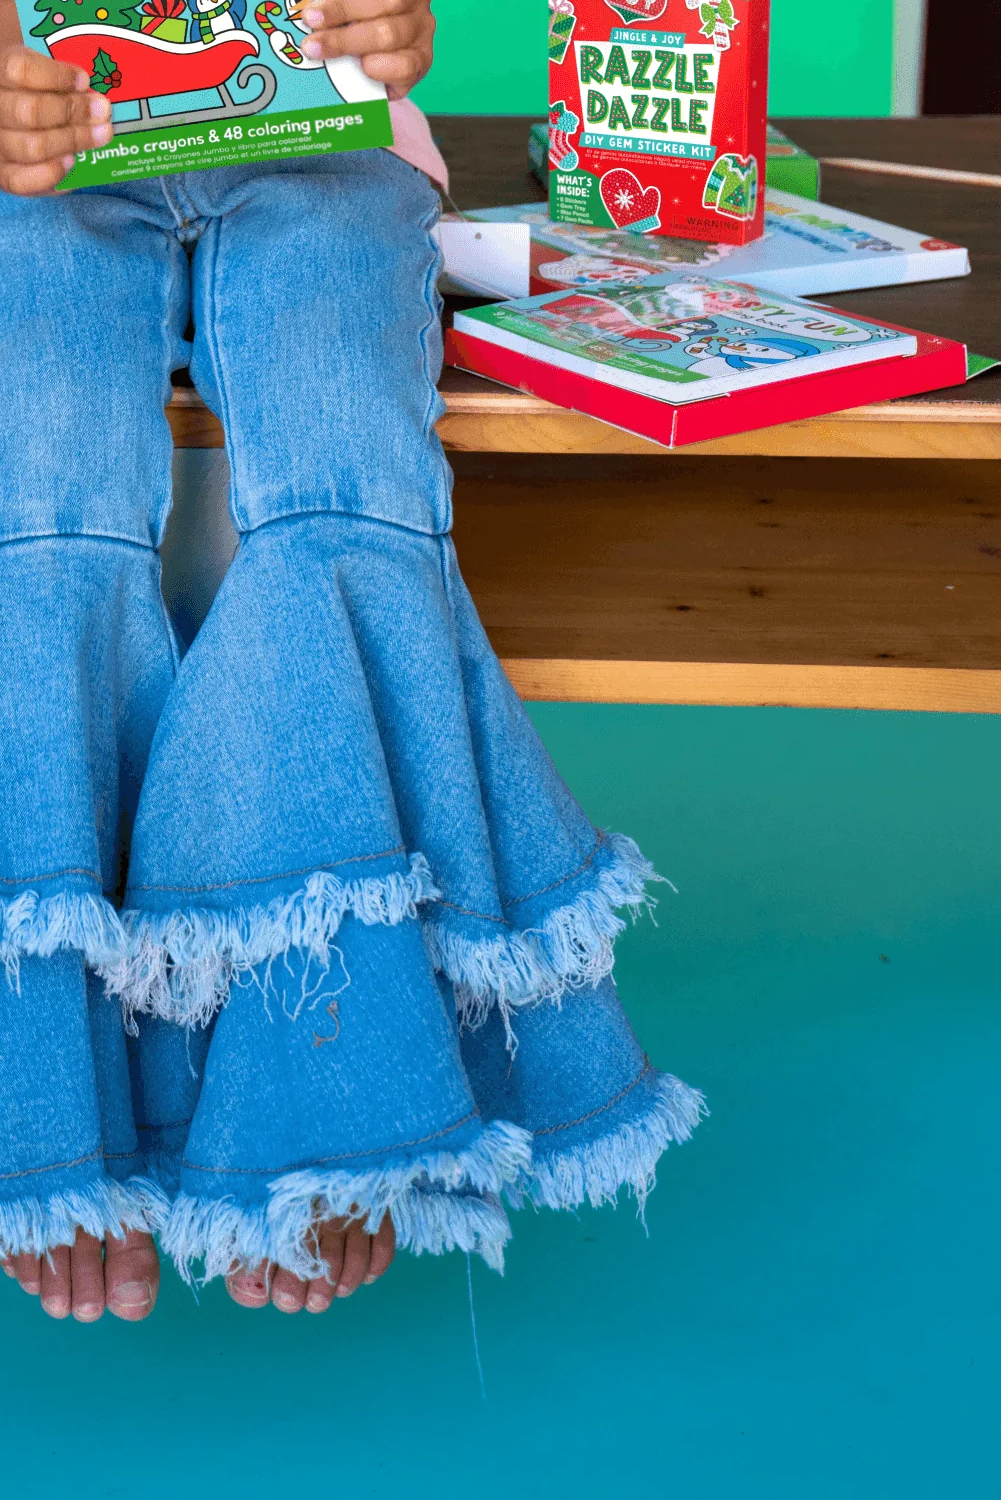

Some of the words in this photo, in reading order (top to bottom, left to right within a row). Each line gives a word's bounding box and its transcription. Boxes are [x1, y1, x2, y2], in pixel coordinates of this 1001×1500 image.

[614, 30, 647, 43] JINGLE
[650, 34, 657, 43] &
[662, 35, 682, 45] JOY
[579, 44, 716, 94] RAZZLE
[586, 89, 707, 135] DAZZLE
[91, 144, 139, 164] jumbo
[143, 134, 205, 153] crayons
[208, 129, 220, 143] &
[223, 126, 243, 141] 48
[247, 120, 311, 138] coloring
[314, 114, 364, 133] pages
[163, 150, 201, 161] Crayones
[202, 146, 230, 156] Jumbo
[238, 142, 256, 151] libro
[257, 140, 277, 149] para
[278, 136, 312, 146] colorear
[585, 134, 604, 146] DIY
[609, 137, 633, 149] GEM
[638, 140, 686, 155] STICKER
[691, 145, 712, 158] KIT
[111, 167, 144, 177] Contient
[152, 161, 184, 172] crayons
[185, 158, 196, 166] de
[197, 156, 212, 165] cire
[213, 153, 239, 164] jumbo
[240, 151, 250, 159] et
[250, 150, 262, 158] un
[262, 147, 280, 156] livre
[293, 141, 333, 153] coloriage
[556, 174, 592, 187] WHAT'S
[556, 185, 590, 198] INSIDE:
[687, 216, 739, 231] WARNING
[787, 315, 859, 337] FUN
